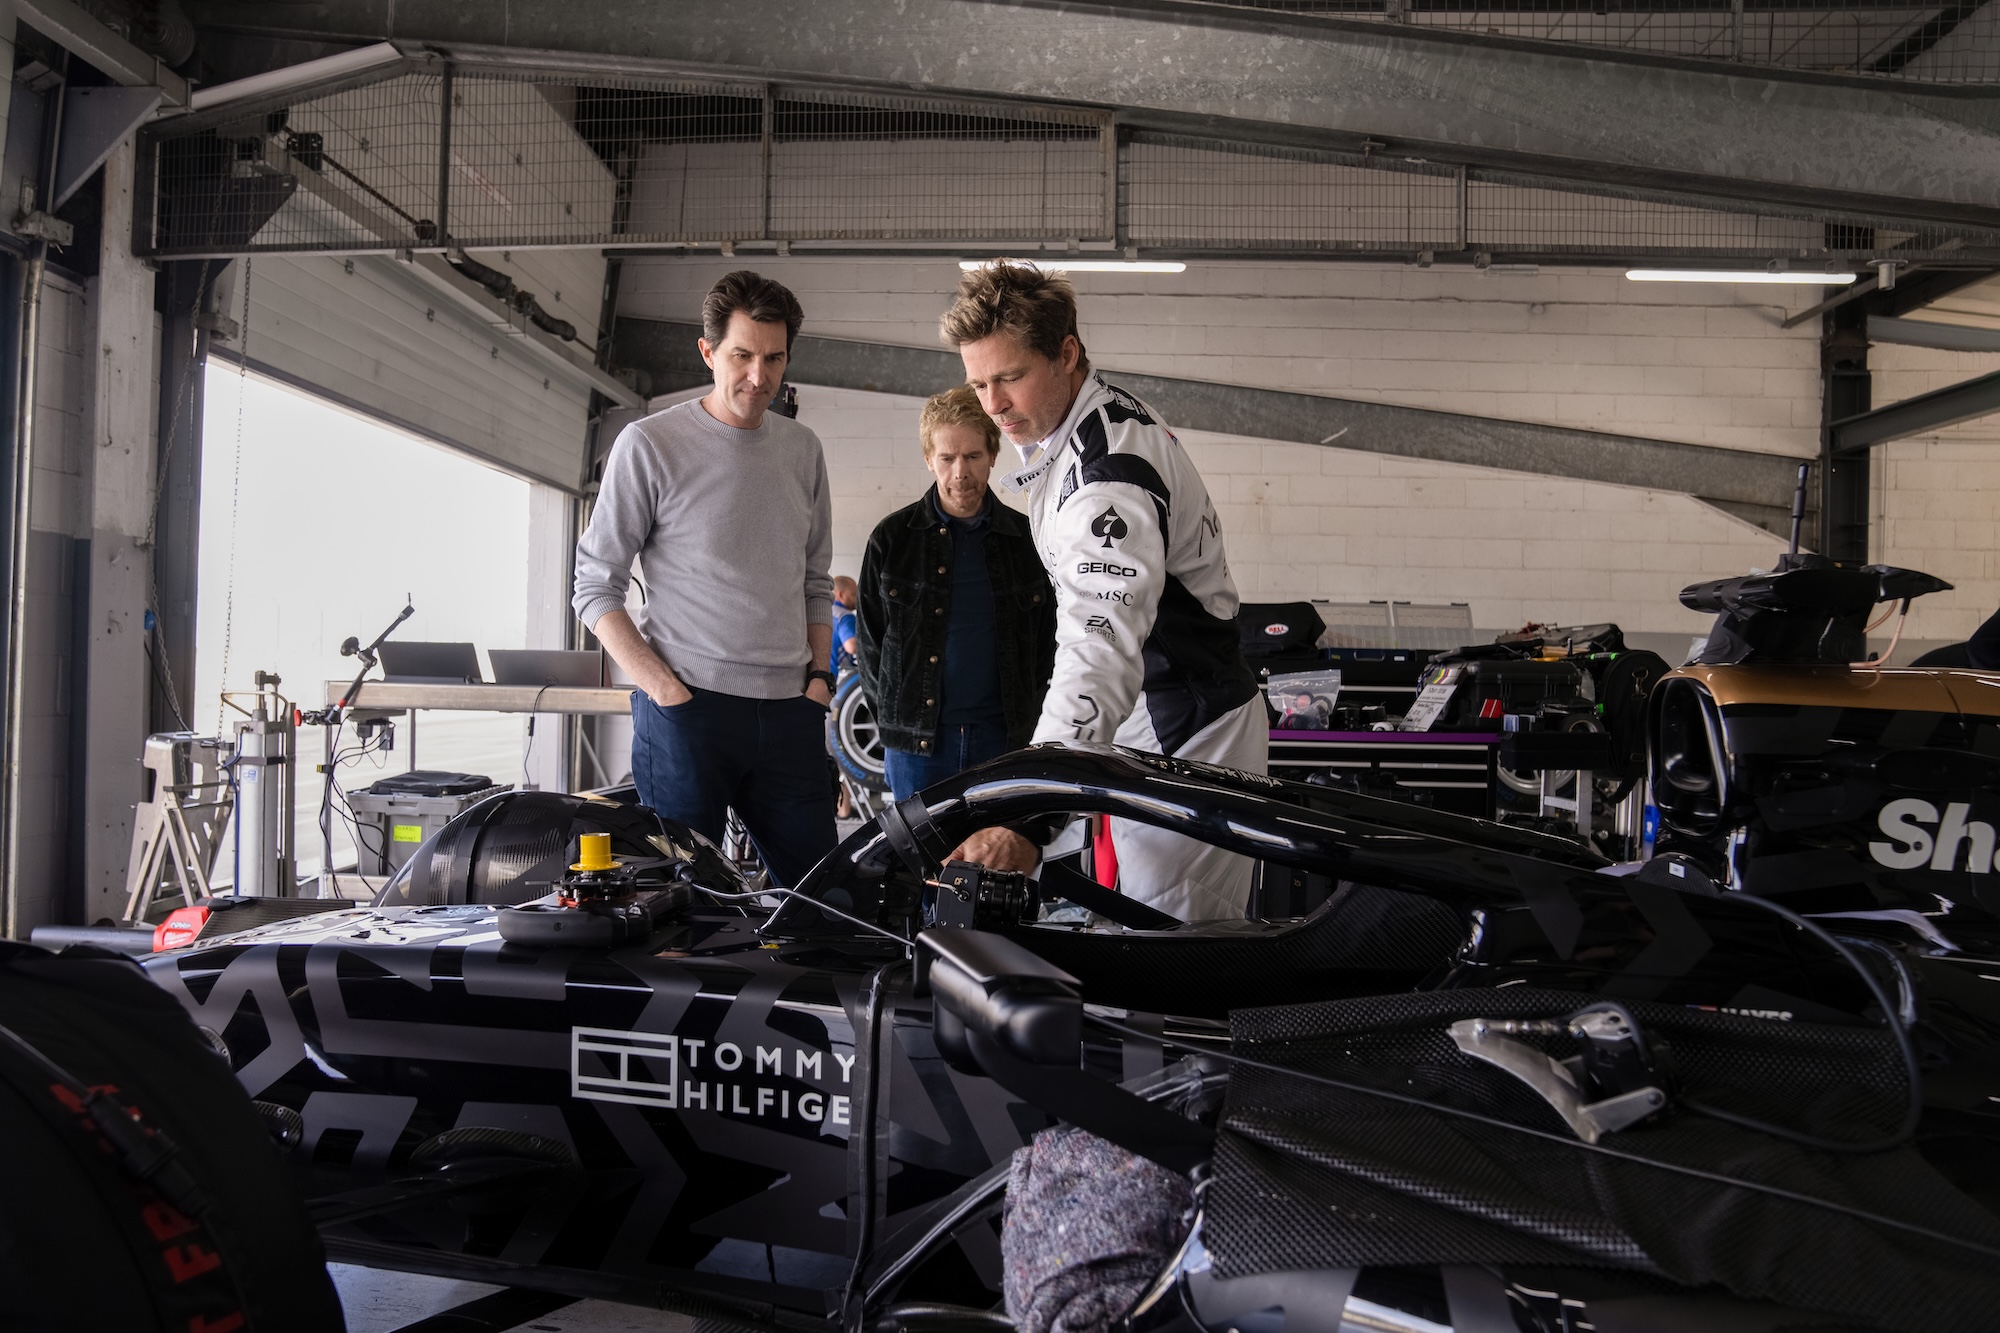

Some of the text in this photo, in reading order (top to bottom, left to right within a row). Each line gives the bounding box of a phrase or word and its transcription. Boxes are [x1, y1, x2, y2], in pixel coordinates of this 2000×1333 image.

[1103, 514, 1119, 534] 7
[1077, 562, 1137, 577] GEICO
[1096, 590, 1134, 607] MSC
[1086, 615, 1116, 634] EA
[1084, 627, 1117, 642] SPORTS
[1868, 798, 2000, 874] Sh
[682, 1038, 856, 1083] TOMMY
[684, 1080, 850, 1125] HILFIGE
